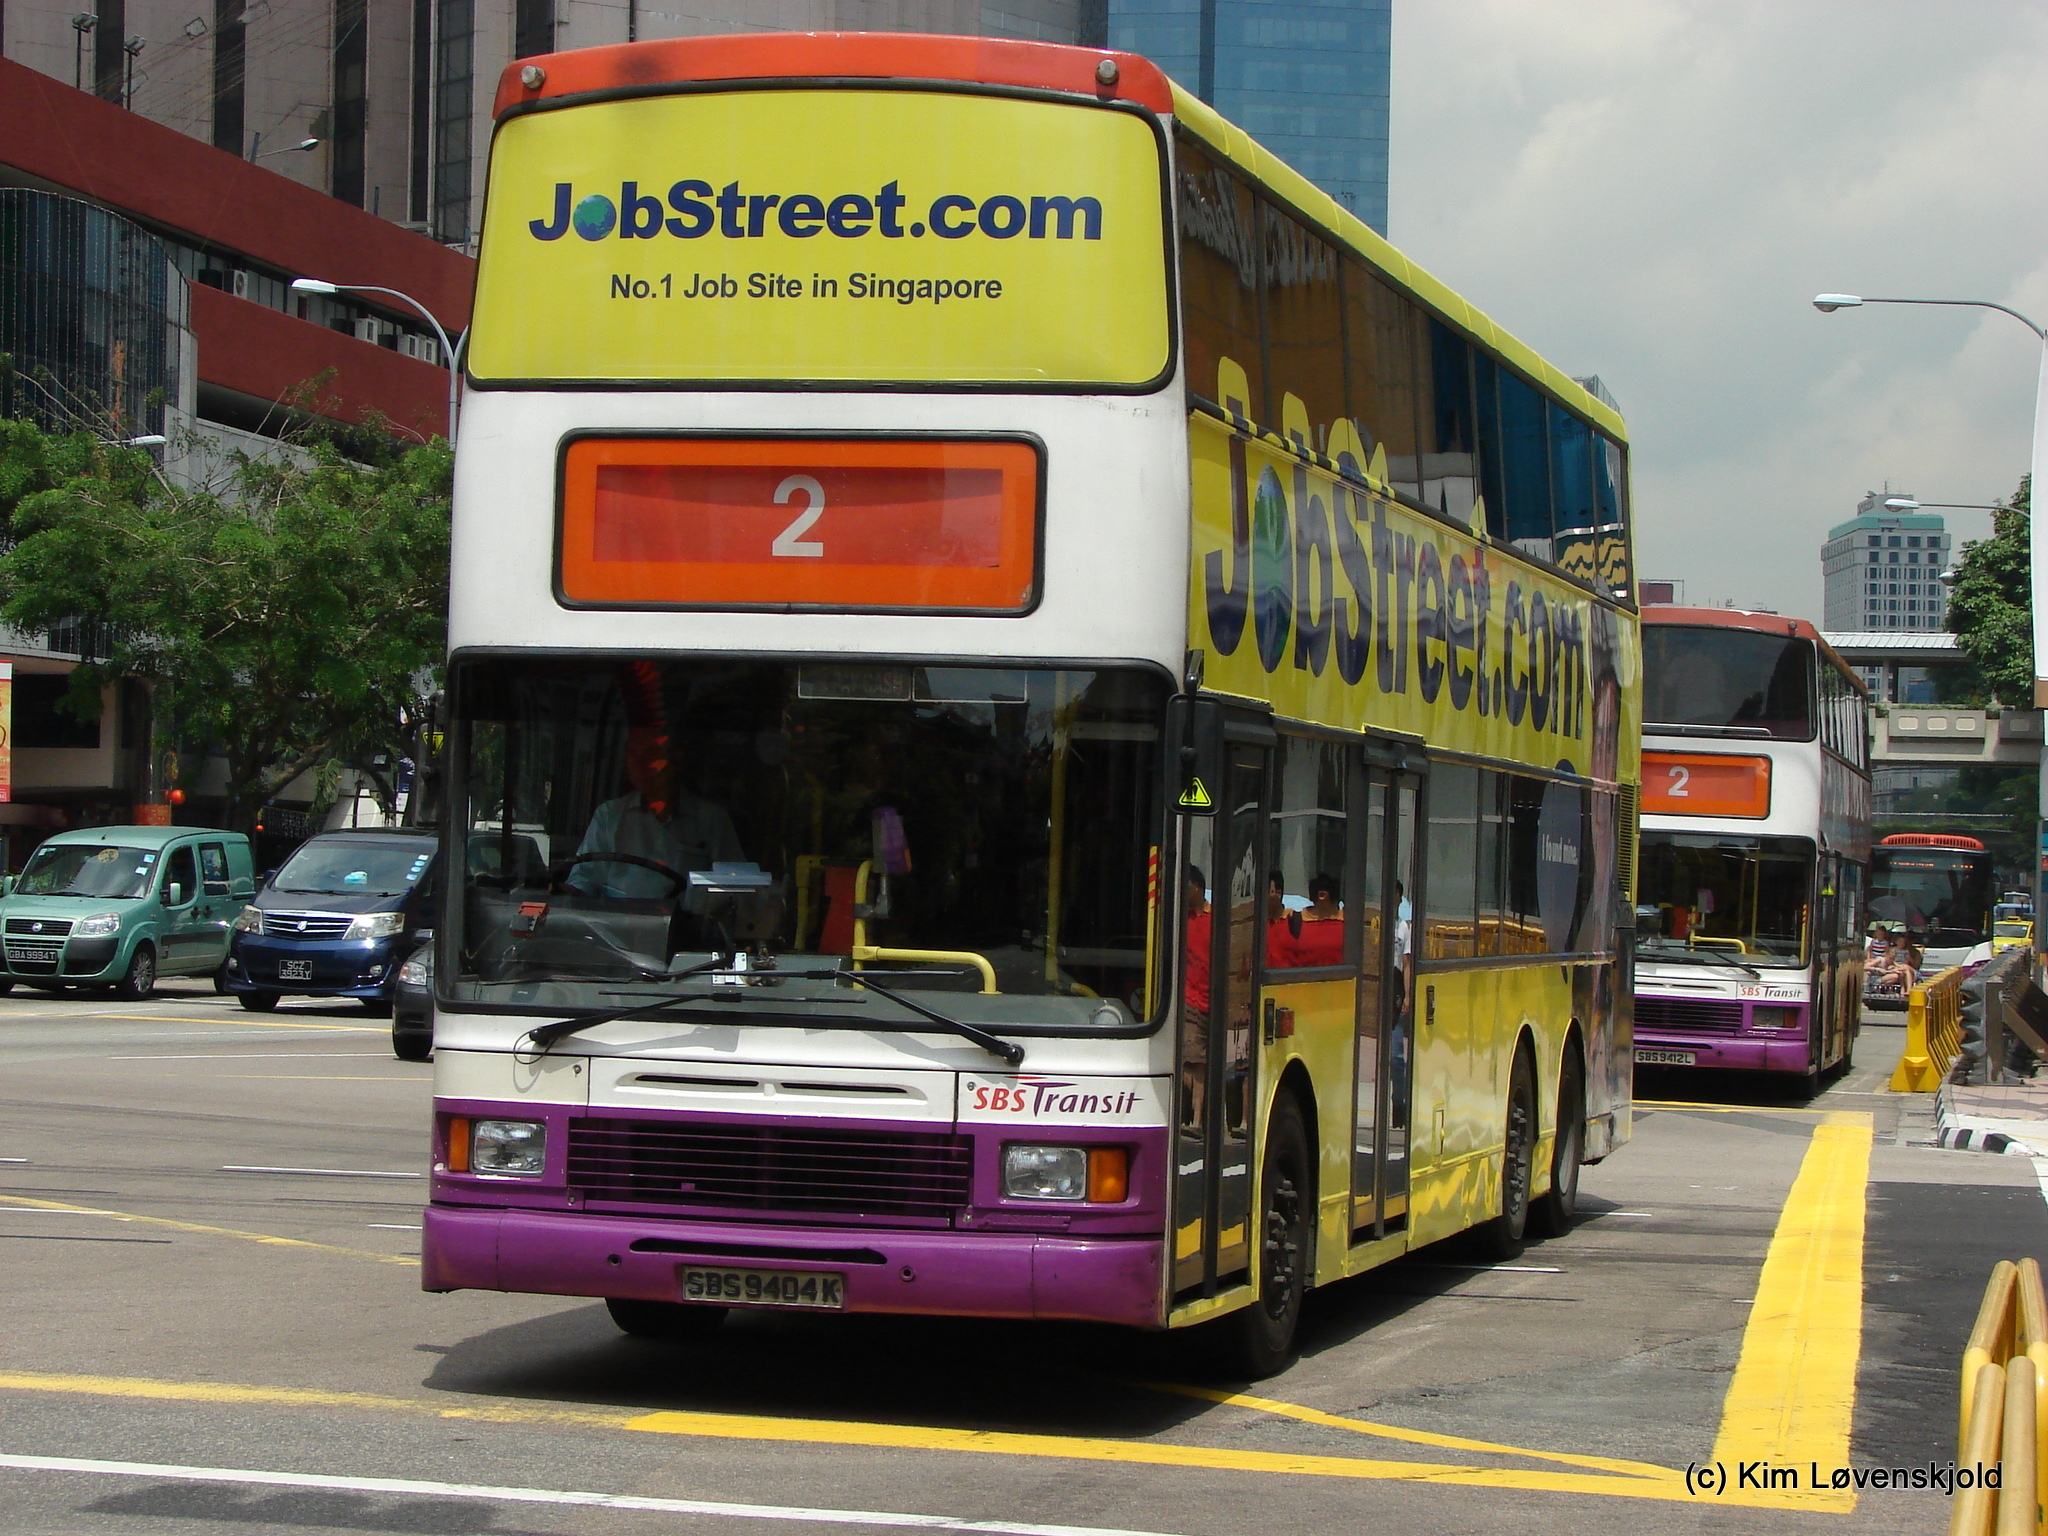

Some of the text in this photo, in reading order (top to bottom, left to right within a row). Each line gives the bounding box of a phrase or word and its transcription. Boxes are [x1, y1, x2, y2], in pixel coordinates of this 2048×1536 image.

[528, 178, 1103, 242] JobStreet.com
[610, 271, 1003, 305] No.1 Job Site in Singapore
[770, 473, 827, 558] 2
[1205, 396, 1584, 741] JobStreet.com
[1667, 765, 1690, 797] 2
[1741, 985, 1803, 998] SBS Transit
[1638, 1051, 1692, 1064] SBS9412L
[973, 1082, 1145, 1118] SBS Transit
[686, 1271, 840, 1303] SBS9404K
